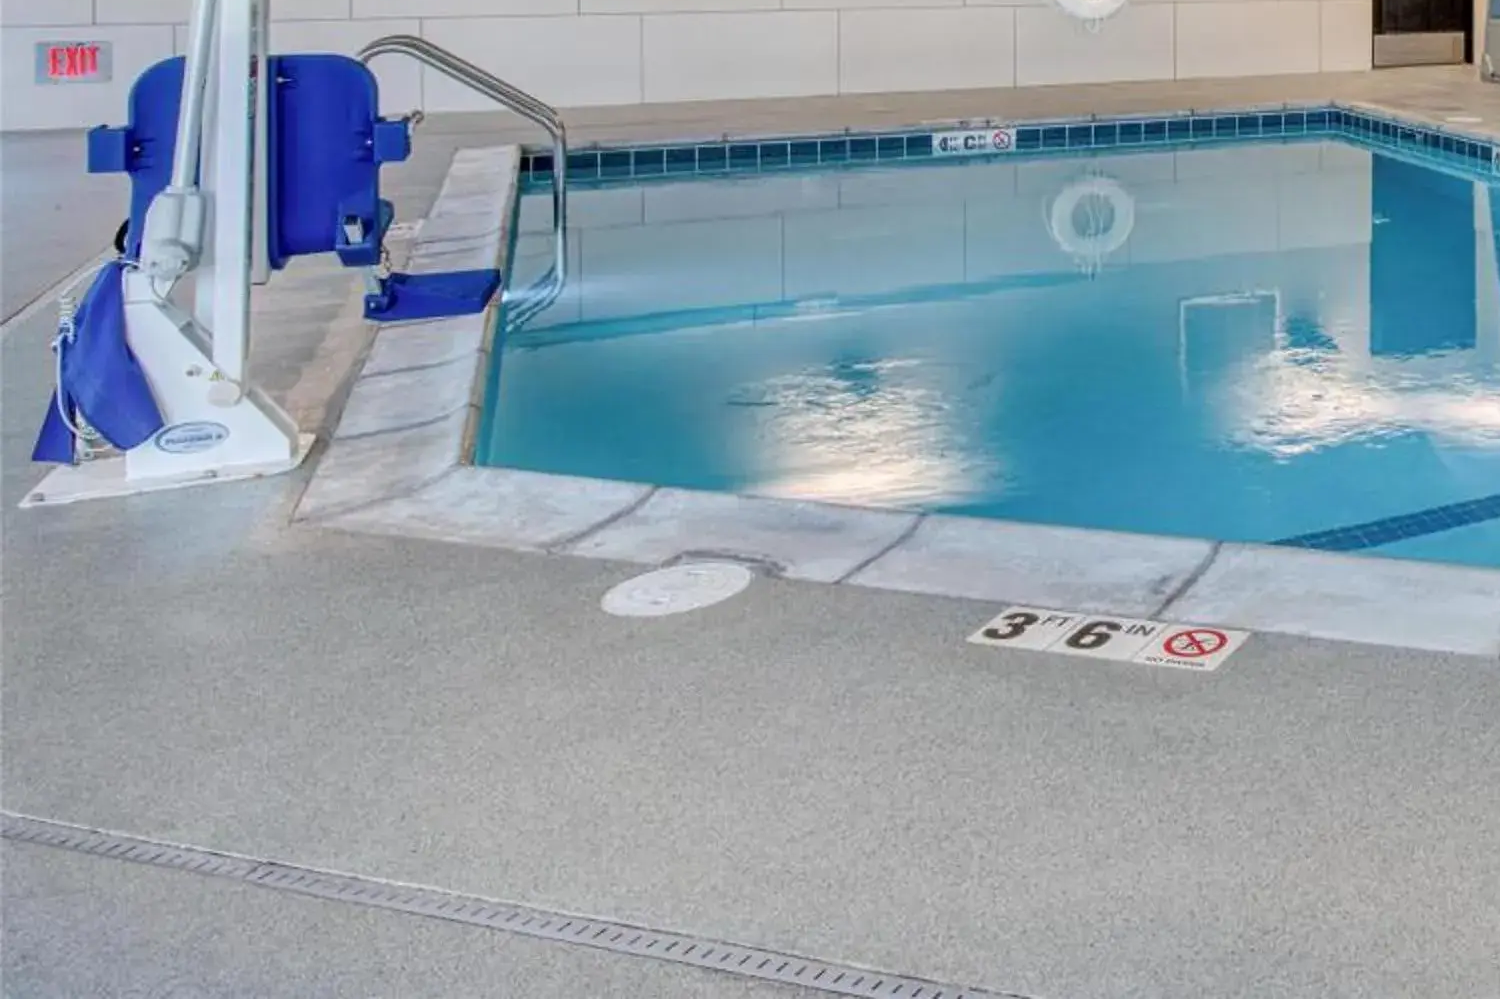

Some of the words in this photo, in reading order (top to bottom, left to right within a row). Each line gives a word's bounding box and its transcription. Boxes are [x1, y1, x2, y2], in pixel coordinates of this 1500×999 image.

[49, 46, 100, 76] EXIT
[982, 612, 1039, 640] 3
[1040, 616, 1070, 626] FT
[1065, 621, 1123, 650] 6
[1124, 624, 1158, 638] IN
